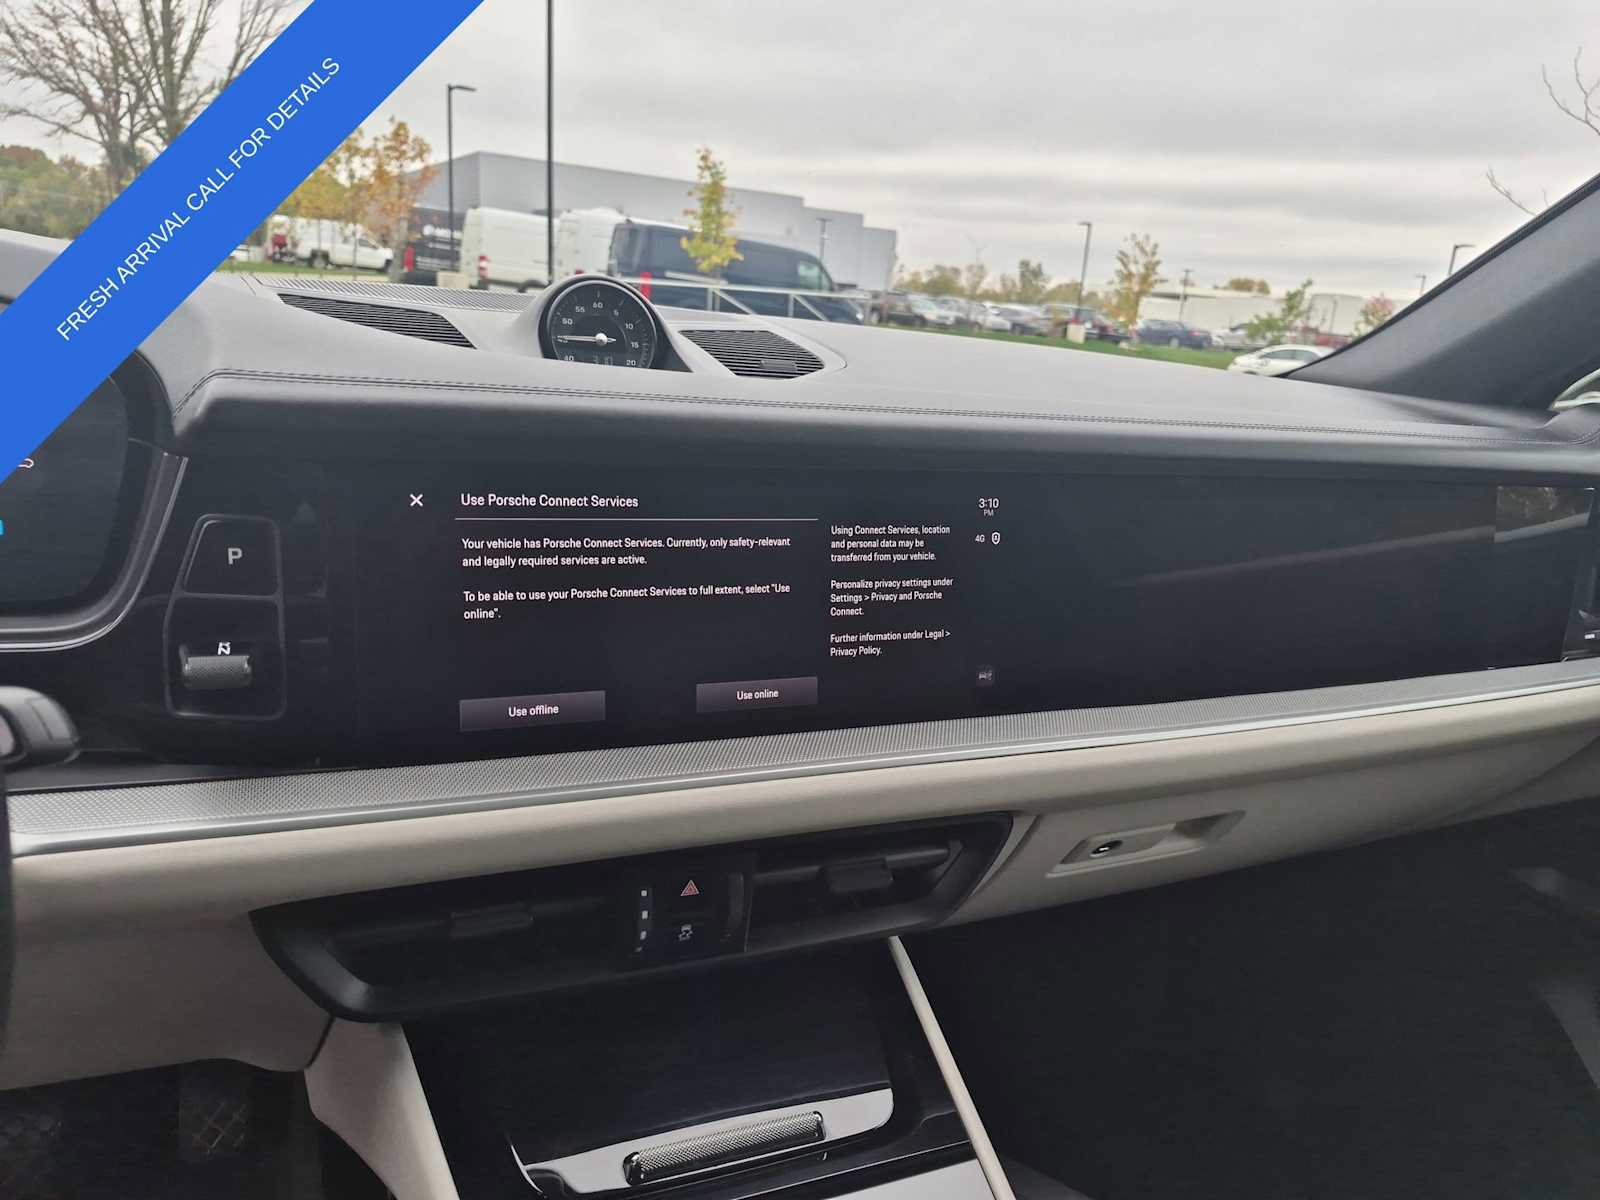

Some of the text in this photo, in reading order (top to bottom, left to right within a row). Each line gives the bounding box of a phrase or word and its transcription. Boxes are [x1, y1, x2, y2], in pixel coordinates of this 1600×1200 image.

[461, 493, 639, 507] Use Porsche Connect Services
[979, 498, 999, 509] 3:10
[983, 509, 994, 517] PM
[831, 525, 950, 537] Using Connect Services, location
[462, 537, 790, 550] Your vehicle has Porsche Connect Services. Currently, only safety-relevant
[831, 538, 924, 550] and personal data may be
[975, 534, 985, 543] 4G
[228, 548, 243, 565] P
[462, 555, 647, 569] and legally required services are active.
[831, 552, 936, 563] transferred from your vehicle.
[831, 578, 953, 590] Personalize privacy settings under
[464, 591, 476, 602] To
[478, 591, 490, 601] be
[492, 590, 514, 601] able
[516, 590, 526, 600] to
[548, 591, 568, 602] your
[570, 588, 608, 598] Porsche
[610, 587, 648, 597] Connect
[650, 586, 686, 596] Services
[689, 586, 698, 595] to
[700, 585, 713, 594] full
[715, 585, 743, 597] extent,
[746, 584, 770, 593] select
[771, 583, 790, 592] "Use
[830, 594, 862, 605] Settings
[871, 593, 897, 604] Privacy
[899, 592, 912, 600] and
[914, 591, 942, 599] Porsche
[464, 608, 502, 619] online".
[830, 607, 864, 616] Connect.
[830, 634, 858, 642] Further
[860, 632, 901, 641] information
[903, 630, 923, 639] under
[925, 629, 944, 641] Legal
[830, 646, 883, 659] Privacy Policy.
[737, 688, 779, 700] Use online
[508, 704, 559, 718] Use offline
